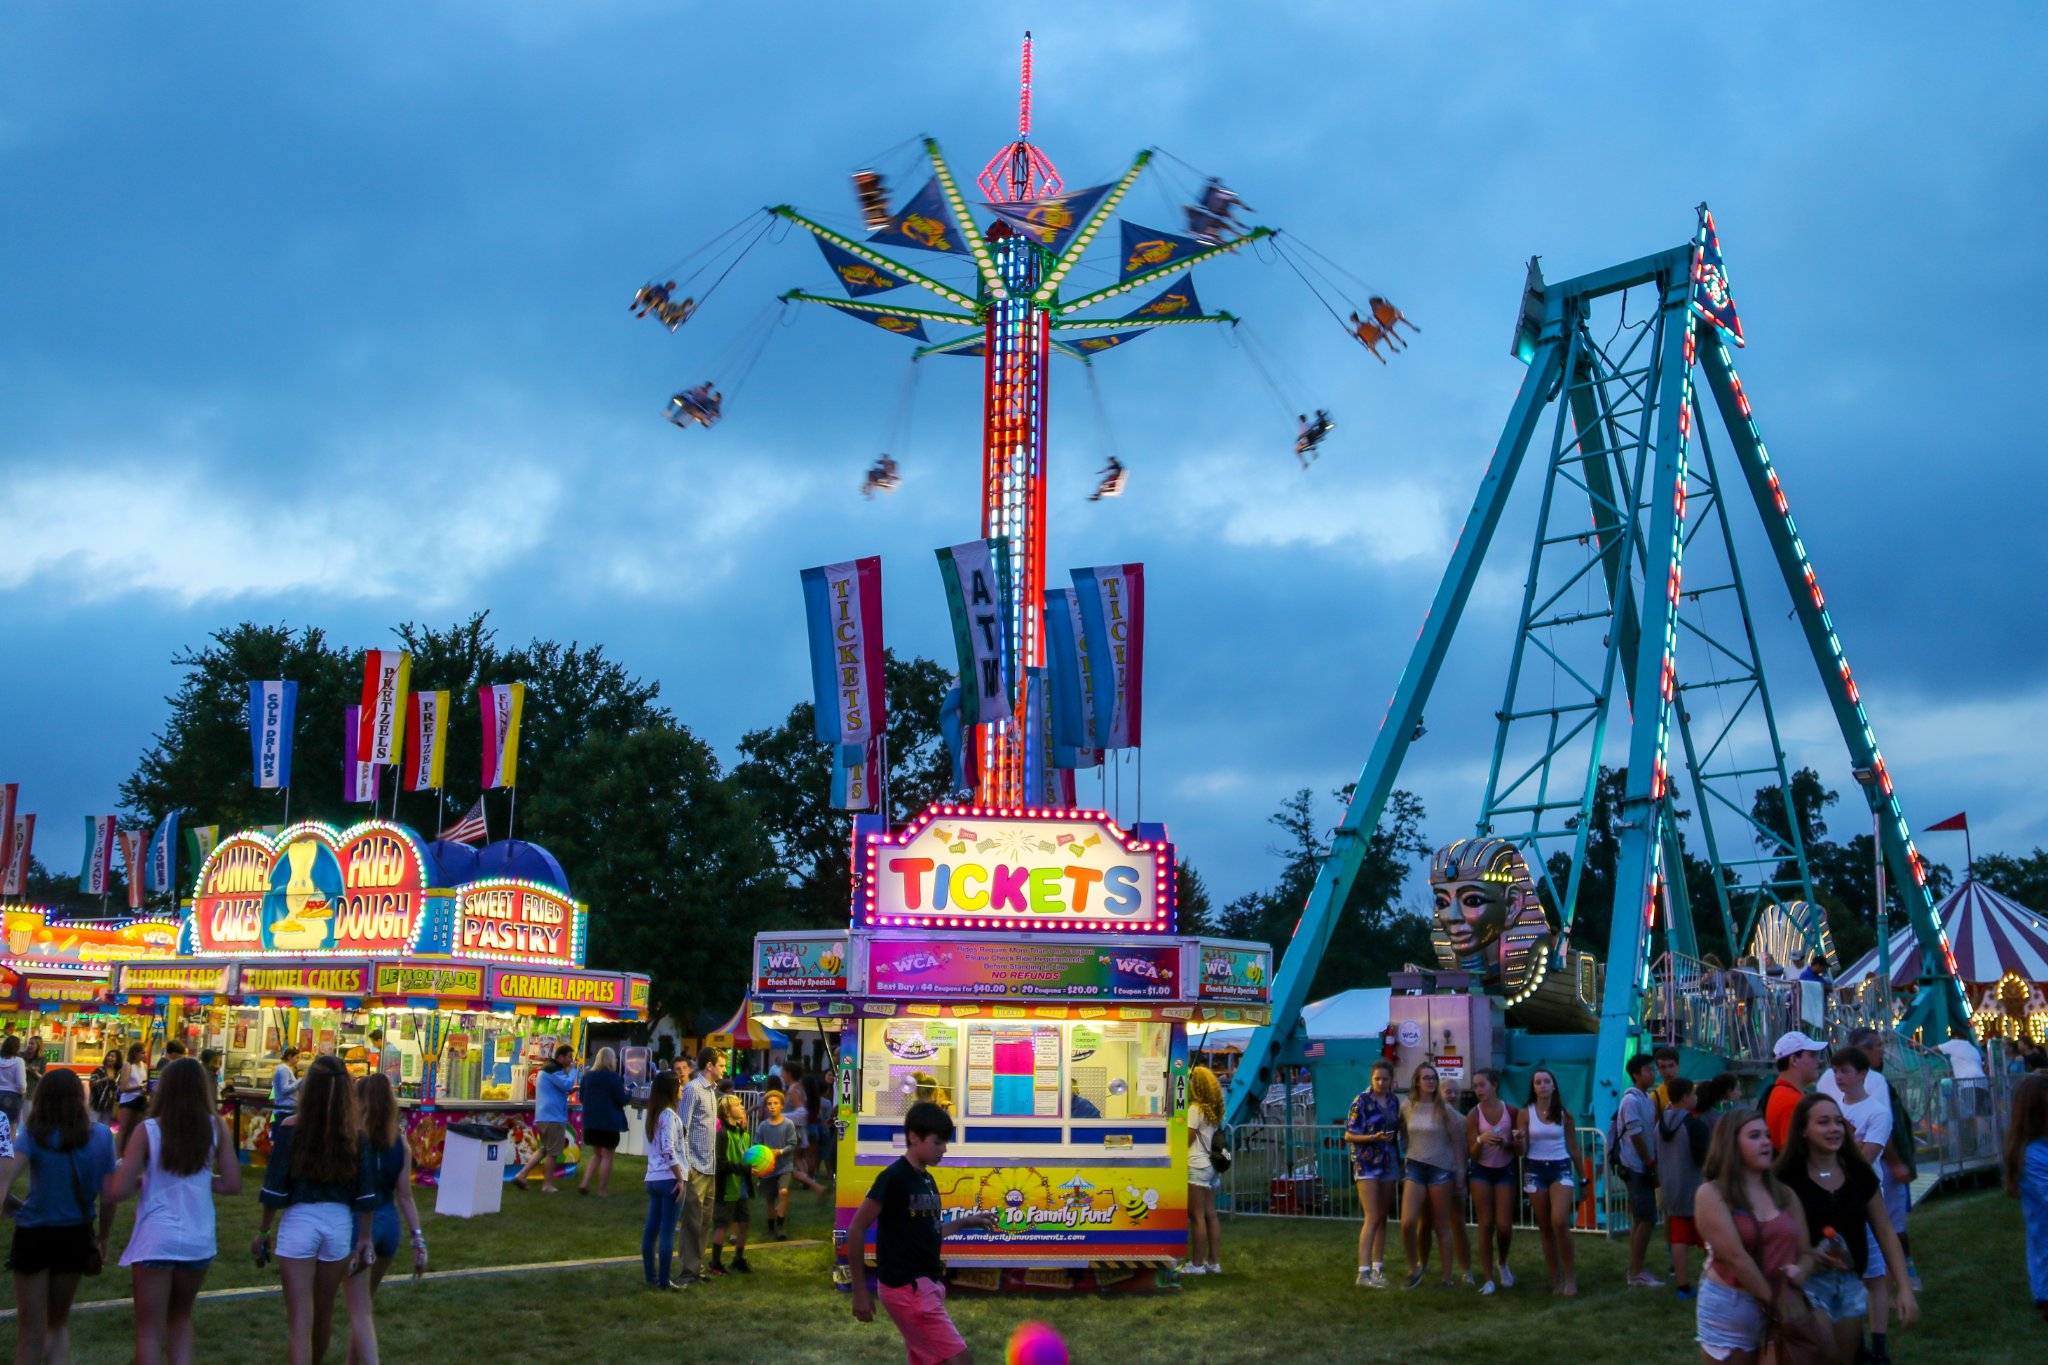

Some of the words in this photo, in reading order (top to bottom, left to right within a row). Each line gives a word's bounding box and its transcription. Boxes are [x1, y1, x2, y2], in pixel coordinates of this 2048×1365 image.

[972, 569, 1000, 699] ATM
[832, 579, 863, 732] TICKETS
[266, 693, 279, 726] COLD
[376, 667, 395, 759] PRETZELS
[264, 730, 277, 778] DRINKS
[420, 701, 434, 785] PRETZELS
[207, 846, 272, 894] FUNNEL
[346, 836, 405, 889] FRIED
[888, 857, 1142, 915] TICKETS
[211, 898, 263, 942] CAKES
[333, 892, 410, 940] DOUGH
[464, 891, 515, 919] SWEET
[519, 893, 563, 924] FRIED
[143, 931, 175, 944] WCA
[441, 900, 450, 948] DRINKS
[462, 917, 563, 954] PASTRY
[767, 956, 802, 968] WCA
[893, 955, 940, 973] WCA
[991, 955, 1015, 963] Check
[1115, 957, 1159, 979] WCA
[1205, 963, 1233, 976] WCA
[126, 969, 188, 991] ELEPHANT
[190, 969, 222, 991] EARS
[246, 968, 305, 992] FUNNEL
[307, 968, 360, 992] CAKES
[380, 968, 477, 991] LEMONADE
[500, 974, 564, 1000] CARAMEL
[565, 978, 615, 1003] APPLES
[767, 978, 788, 986] Check
[788, 978, 806, 987] Daily
[807, 978, 836, 987] Specials
[876, 982, 896, 991] Best
[898, 983, 915, 993] Buy
[921, 983, 933, 992] 44
[934, 985, 961, 993] Coupons
[962, 985, 972, 993] for
[973, 984, 1005, 993] $40.00
[1021, 985, 1033, 993] 20
[1034, 986, 1062, 995] Coupons
[1067, 985, 1098, 994] $20.00
[1118, 987, 1142, 996] Coupon
[1147, 986, 1171, 995] $1.00
[992, 971, 1007, 979] NO
[1010, 972, 1060, 980] REFUNDS
[1205, 984, 1222, 993] Check
[1223, 985, 1236, 995] Daily
[1237, 986, 1259, 995] Specials
[867, 1004, 892, 1014] TICKETS
[842, 1069, 851, 1105] ATM
[1176, 1076, 1185, 1110] ATM
[1005, 1206, 1023, 1223] To
[1026, 1205, 1079, 1227] Family
[1080, 1205, 1116, 1224] Fun!
